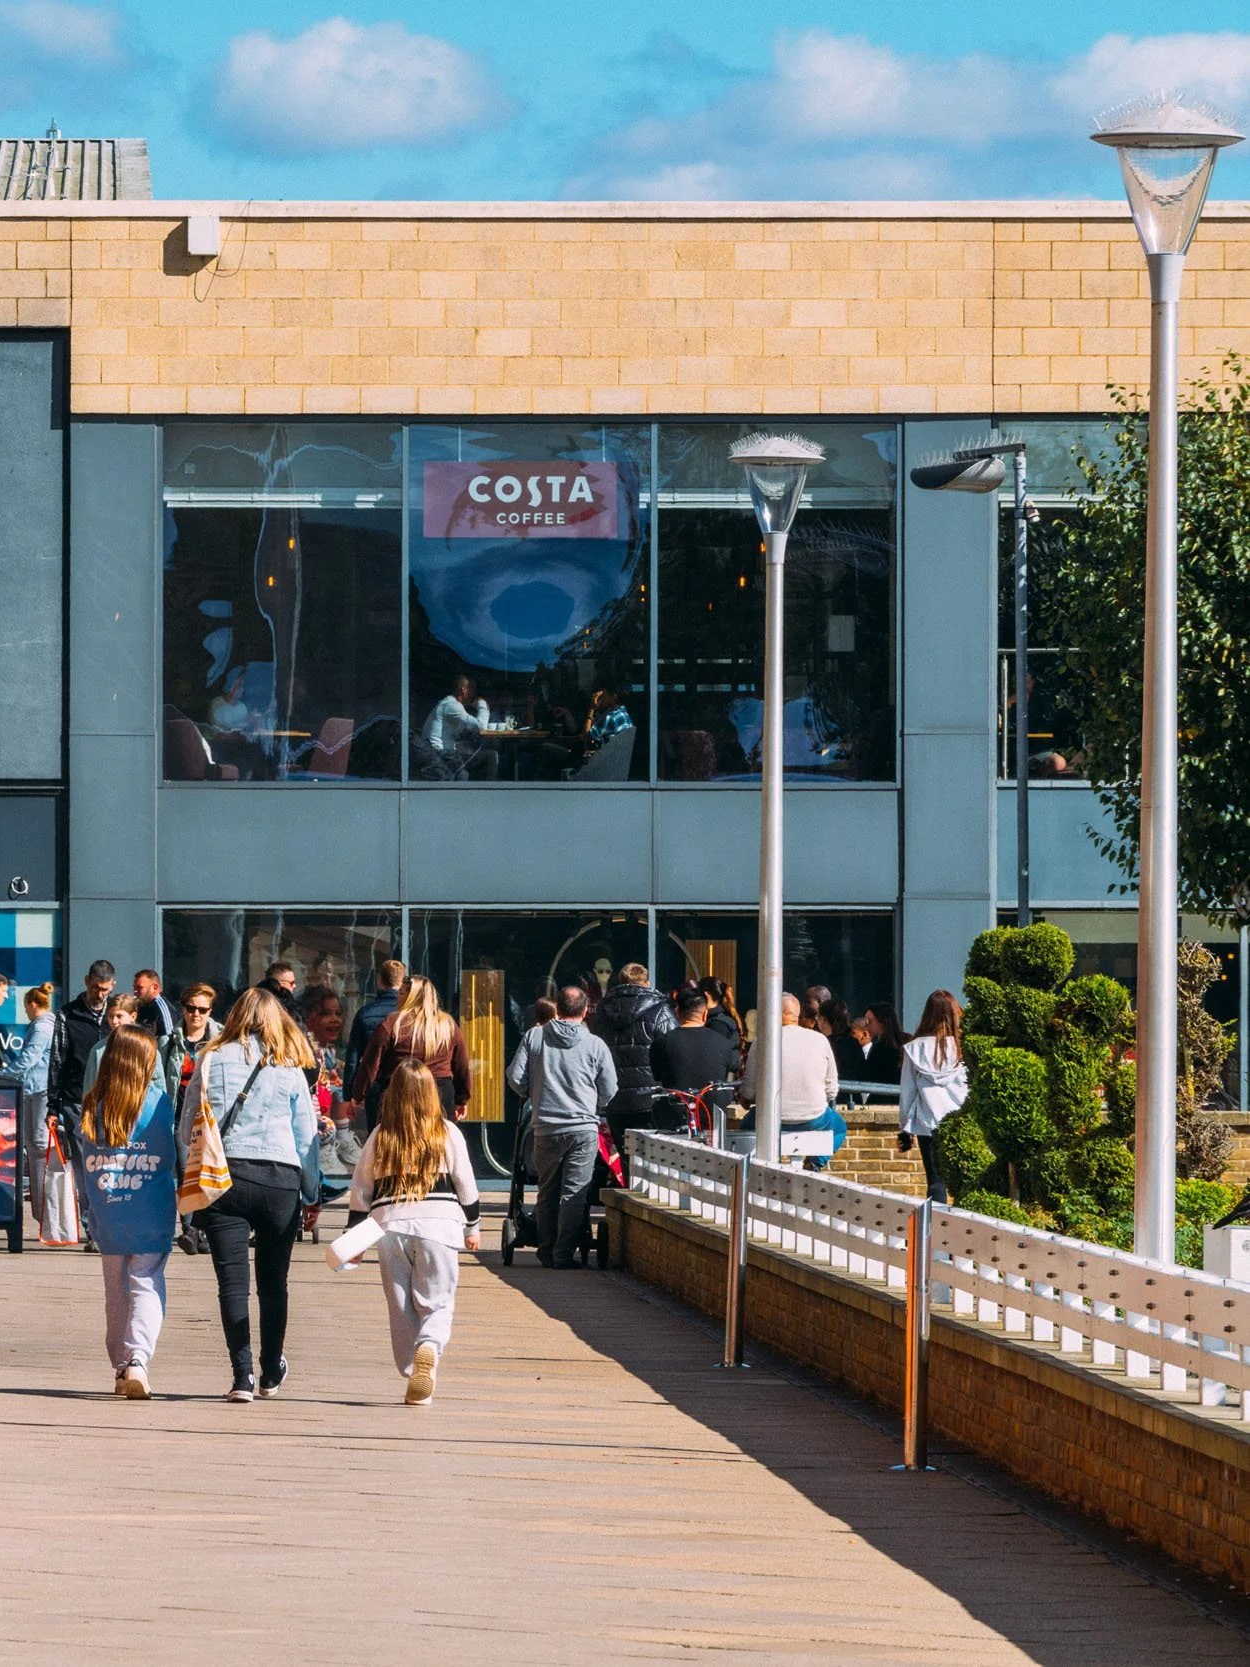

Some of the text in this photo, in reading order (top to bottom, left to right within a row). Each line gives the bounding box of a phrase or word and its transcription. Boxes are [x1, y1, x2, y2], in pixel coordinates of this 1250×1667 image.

[468, 475, 594, 508] COSTA
[496, 512, 566, 525] COFFEE
[85, 1153, 162, 1173] COMFORT
